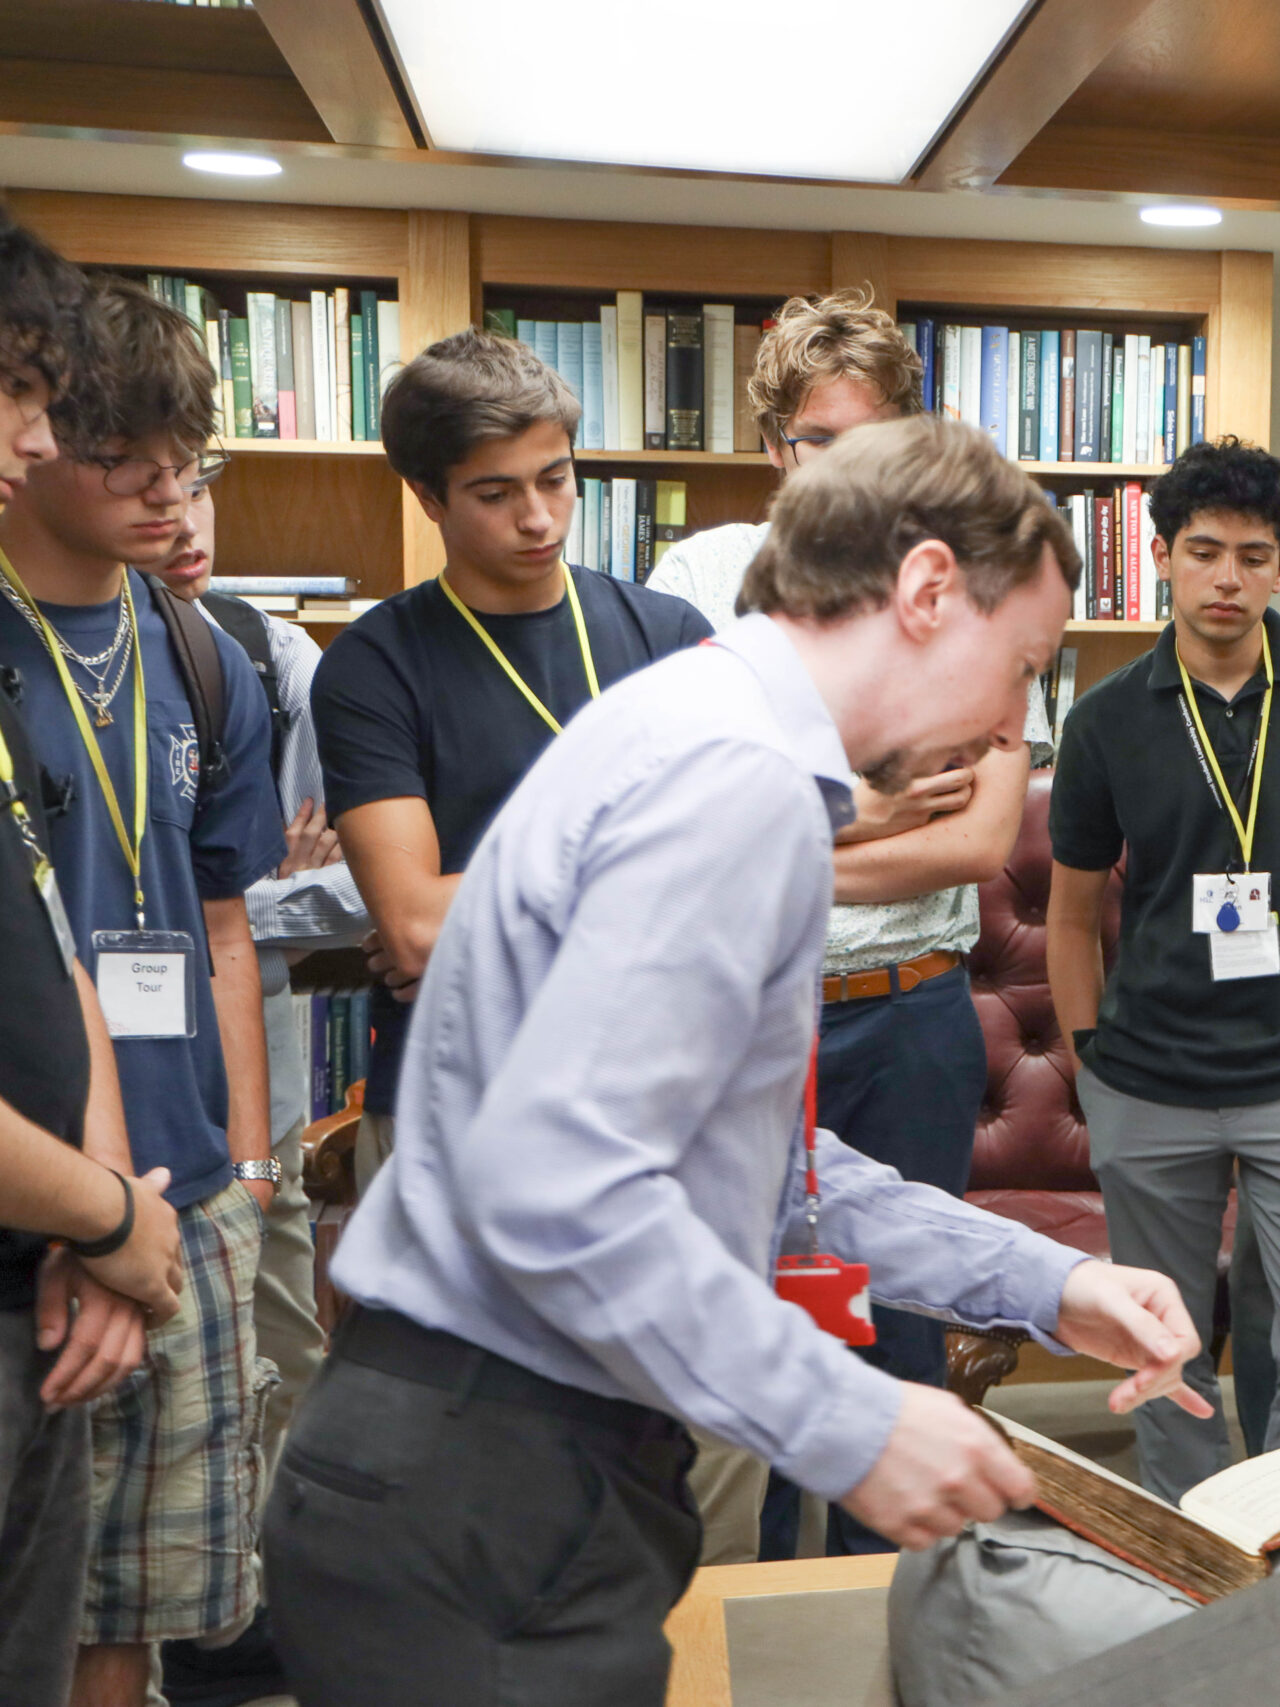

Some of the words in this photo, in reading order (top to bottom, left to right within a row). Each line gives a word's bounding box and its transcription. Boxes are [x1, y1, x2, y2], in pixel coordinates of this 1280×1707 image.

[1167, 410, 1175, 431] Sidnie
[1130, 500, 1138, 536] NEWTON
[1130, 538, 1138, 555] THE
[1130, 556, 1138, 603] ALCHEMIST
[1187, 726, 1204, 759] Leadership
[1200, 758, 1213, 784] Student
[131, 962, 168, 975] Group
[136, 982, 162, 992] Tour
